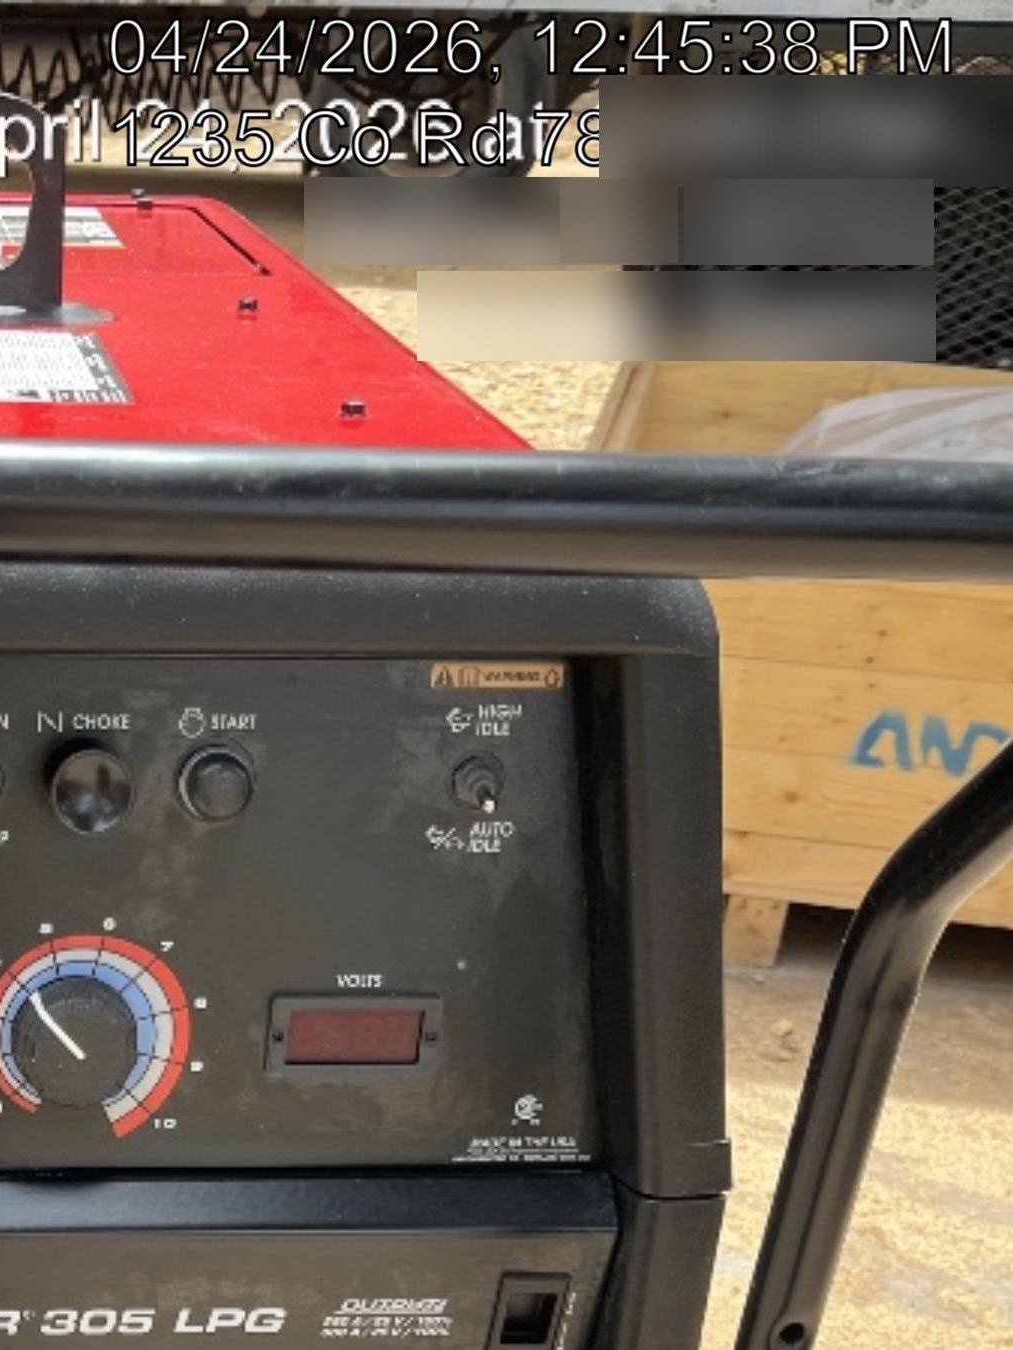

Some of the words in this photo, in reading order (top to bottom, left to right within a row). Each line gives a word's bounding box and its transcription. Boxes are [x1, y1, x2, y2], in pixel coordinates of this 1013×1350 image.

[478, 704, 523, 720] HIGH
[73, 713, 131, 730] CHOKE
[211, 714, 257, 730] START
[475, 722, 511, 736] IDLE
[470, 821, 515, 838] AUTO
[467, 839, 501, 853] IDLE
[103, 917, 116, 931] 6
[335, 973, 384, 988] VOLTS
[154, 1118, 177, 1130] 10
[40, 1308, 156, 1335] 305
[173, 1307, 287, 1333] LPG
